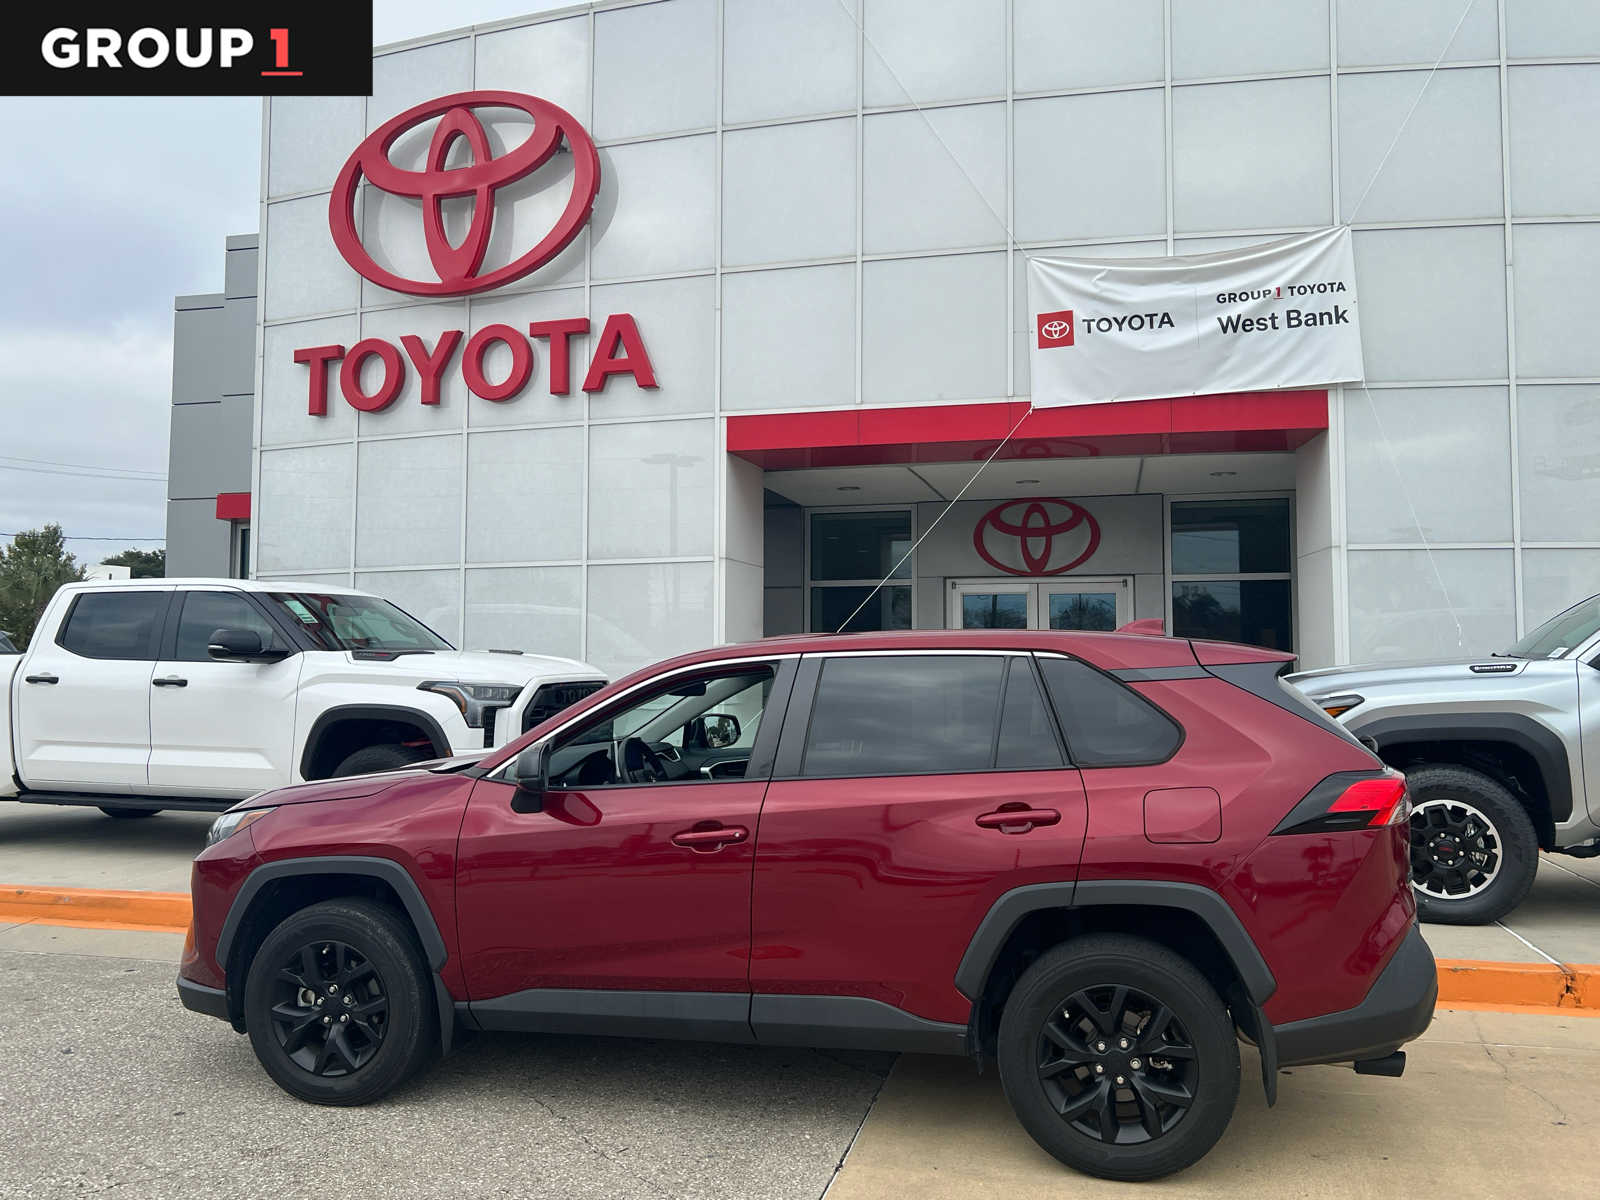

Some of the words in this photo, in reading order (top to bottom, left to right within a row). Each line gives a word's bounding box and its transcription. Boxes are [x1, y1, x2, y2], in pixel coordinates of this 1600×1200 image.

[1216, 289, 1272, 304] GROUP
[1288, 281, 1346, 297] TOYOTA
[1082, 312, 1175, 334] TOYOTA
[1217, 313, 1279, 334] West
[1286, 305, 1349, 329] Bank
[294, 313, 659, 416] TOYOTA
